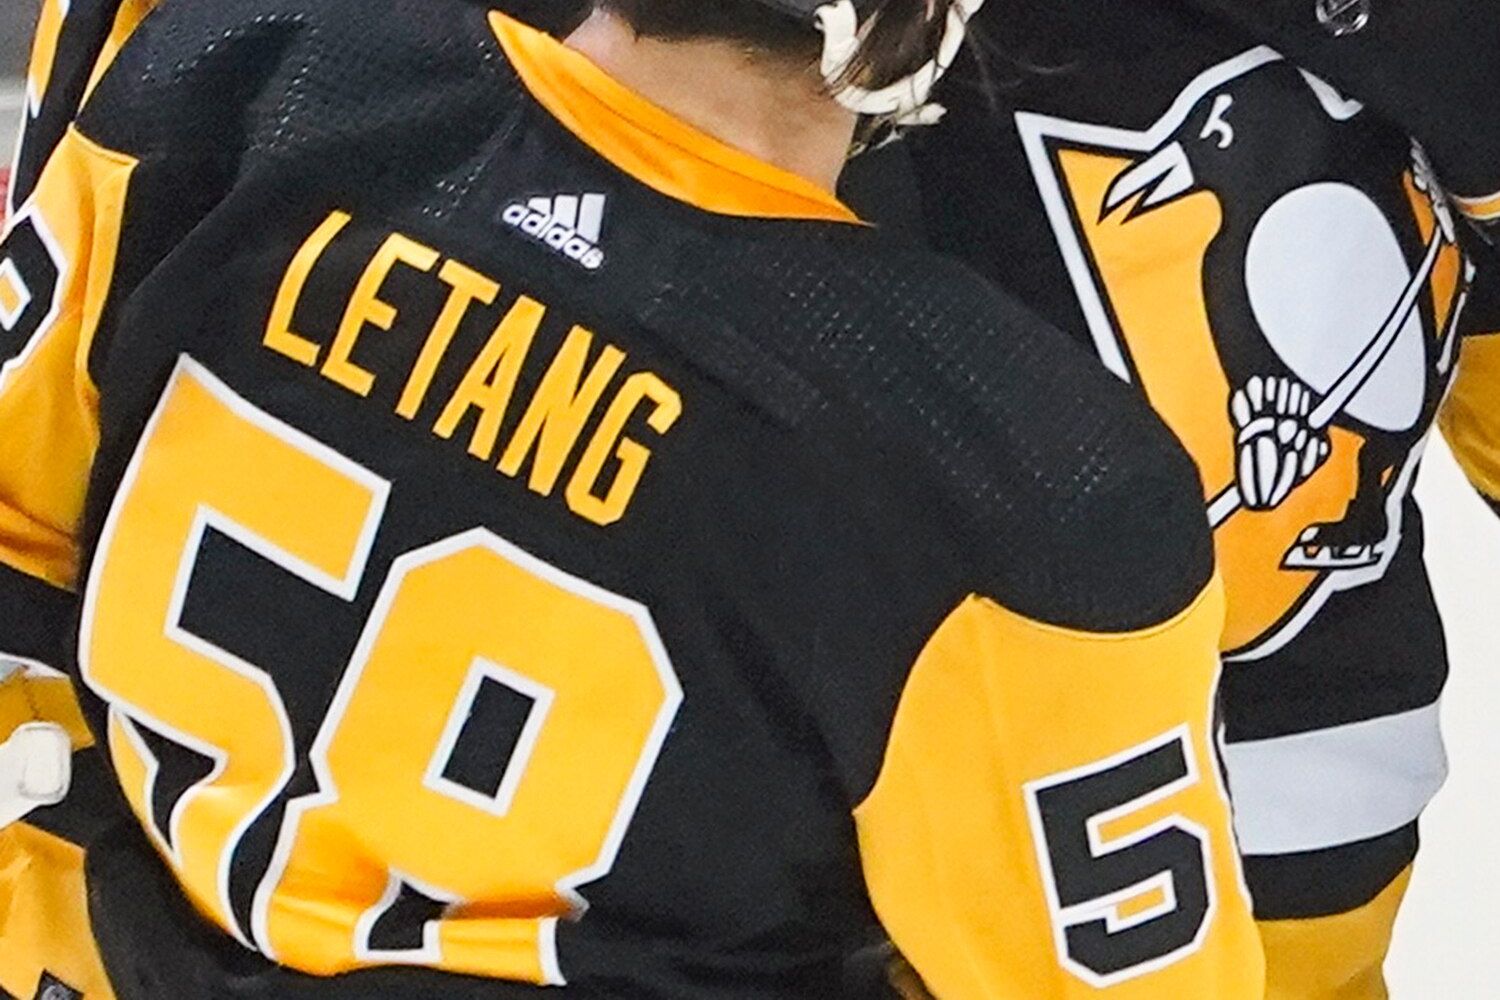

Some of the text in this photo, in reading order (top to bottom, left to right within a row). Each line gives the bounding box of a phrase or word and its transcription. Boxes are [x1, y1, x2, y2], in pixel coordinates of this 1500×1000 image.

[262, 210, 682, 526] LETANG
[502, 204, 604, 269] adidas
[78, 352, 684, 986] 58
[1023, 721, 1225, 989] 5
